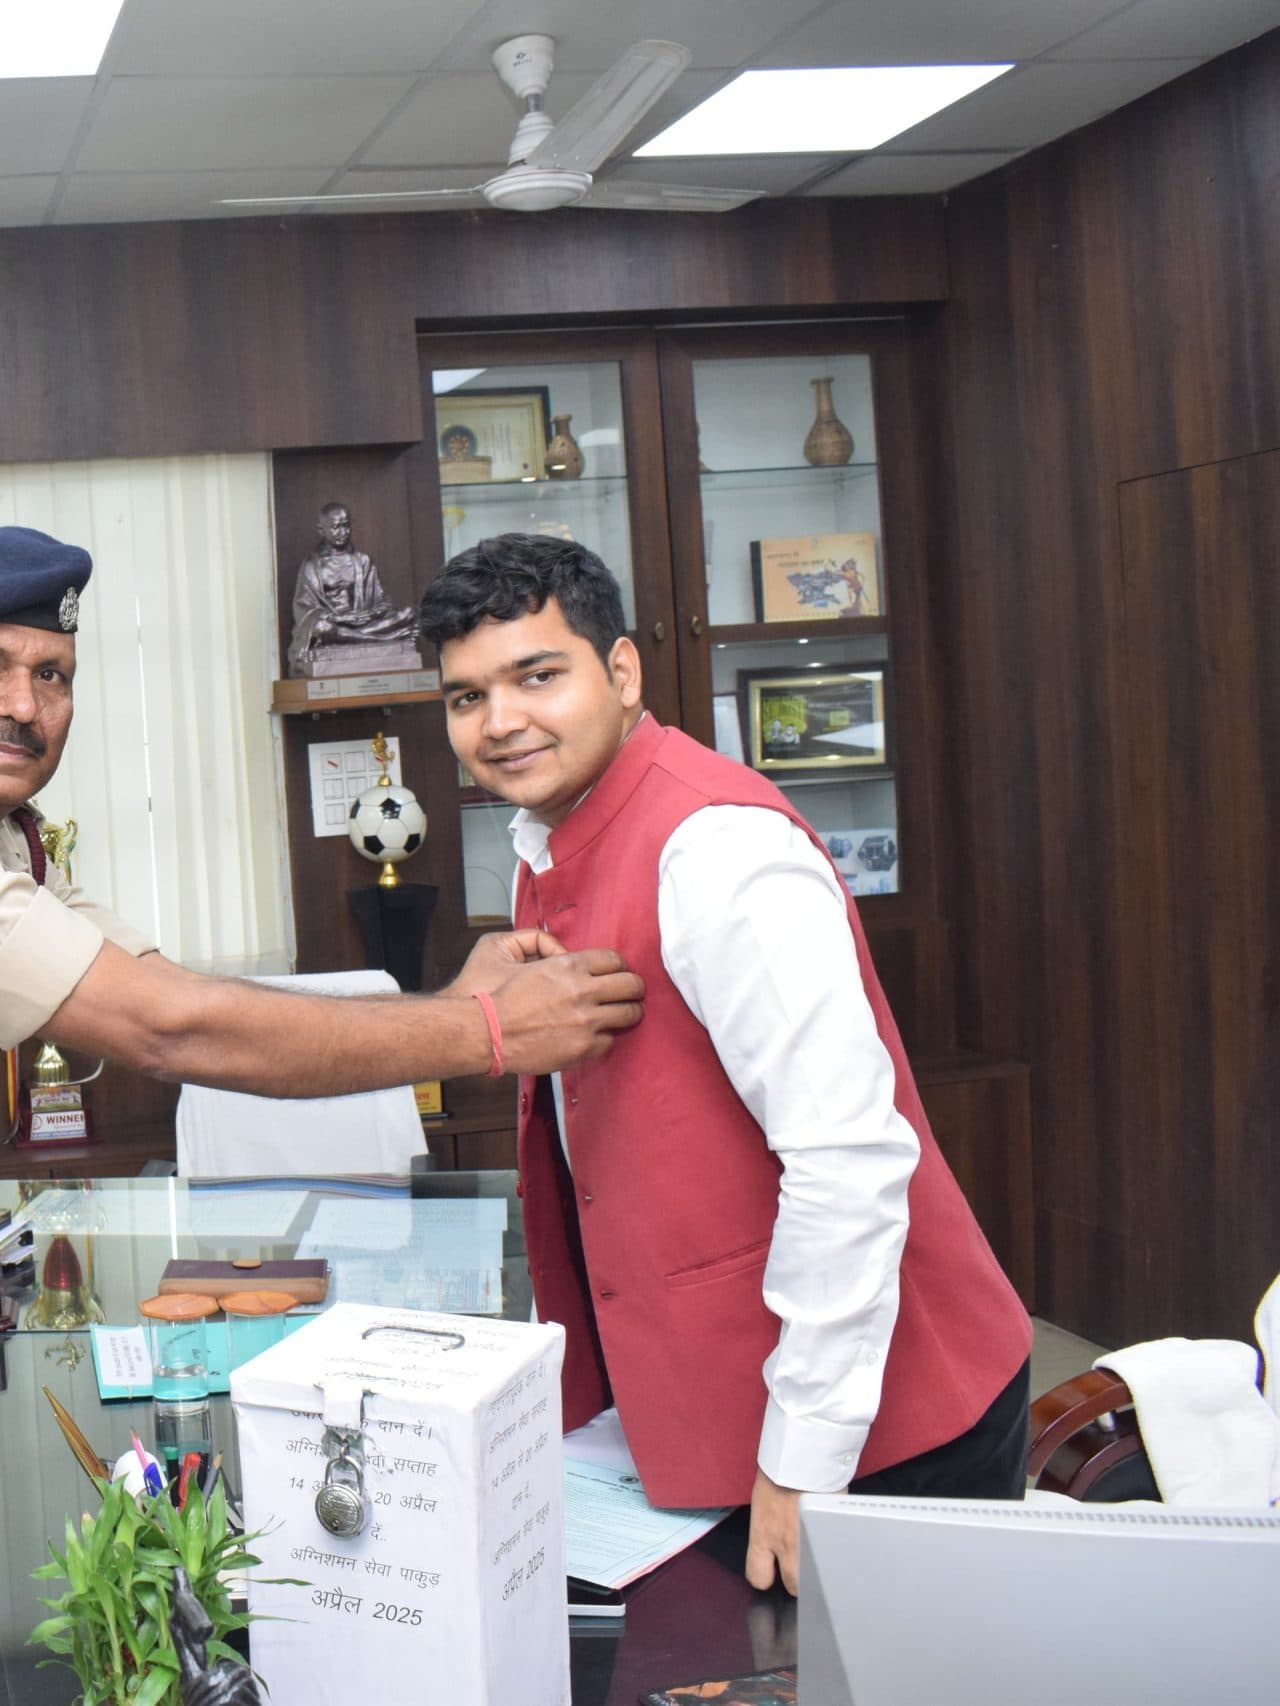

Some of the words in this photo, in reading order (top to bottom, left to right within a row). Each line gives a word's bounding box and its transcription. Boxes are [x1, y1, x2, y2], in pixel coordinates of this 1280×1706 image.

[392, 1456, 439, 1478] सप्ताह
[289, 1476, 305, 1490] 14
[374, 1491, 393, 1506] 20
[399, 1492, 439, 1513] अप्रैल
[289, 1545, 358, 1571] अग्निशमन
[364, 1556, 393, 1578] सेवा
[525, 1546, 545, 1580] 2025
[311, 1586, 364, 1615] अप्रैल
[372, 1601, 424, 1627] 2025
